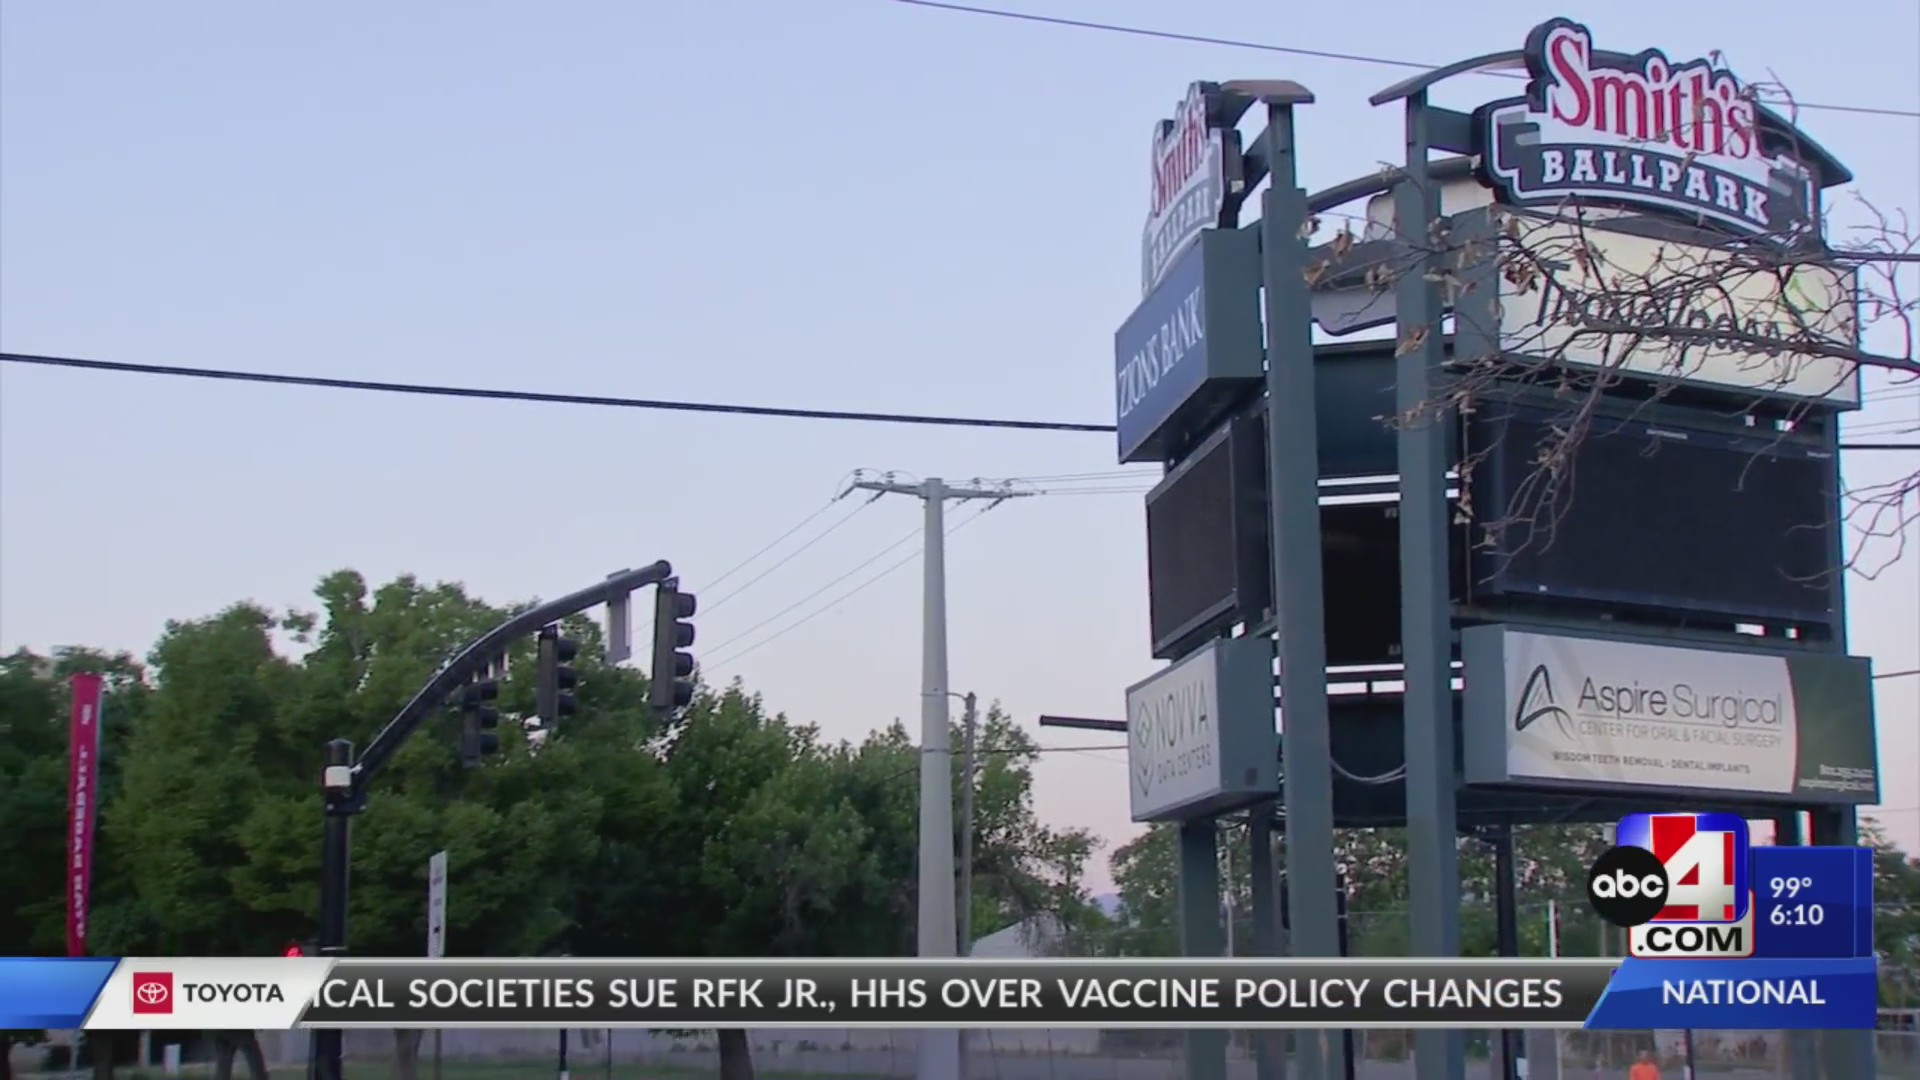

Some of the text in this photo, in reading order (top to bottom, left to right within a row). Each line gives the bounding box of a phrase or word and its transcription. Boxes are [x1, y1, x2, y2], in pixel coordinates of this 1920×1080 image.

[1552, 34, 1764, 161] Smith's
[1543, 149, 1770, 226] BALLPARK
[1118, 286, 1203, 418] ZIONS BANK
[1154, 678, 1210, 752] NOVVA
[1577, 676, 1782, 728] Aspire Surgical
[1177, 744, 1212, 777] CENTERS
[1552, 750, 1751, 775] WISDOM TEETH REMOVAL DENTAL IMPLANTS
[1578, 719, 1783, 749] CENTER FOR ORAL & FACIAL SURGERY
